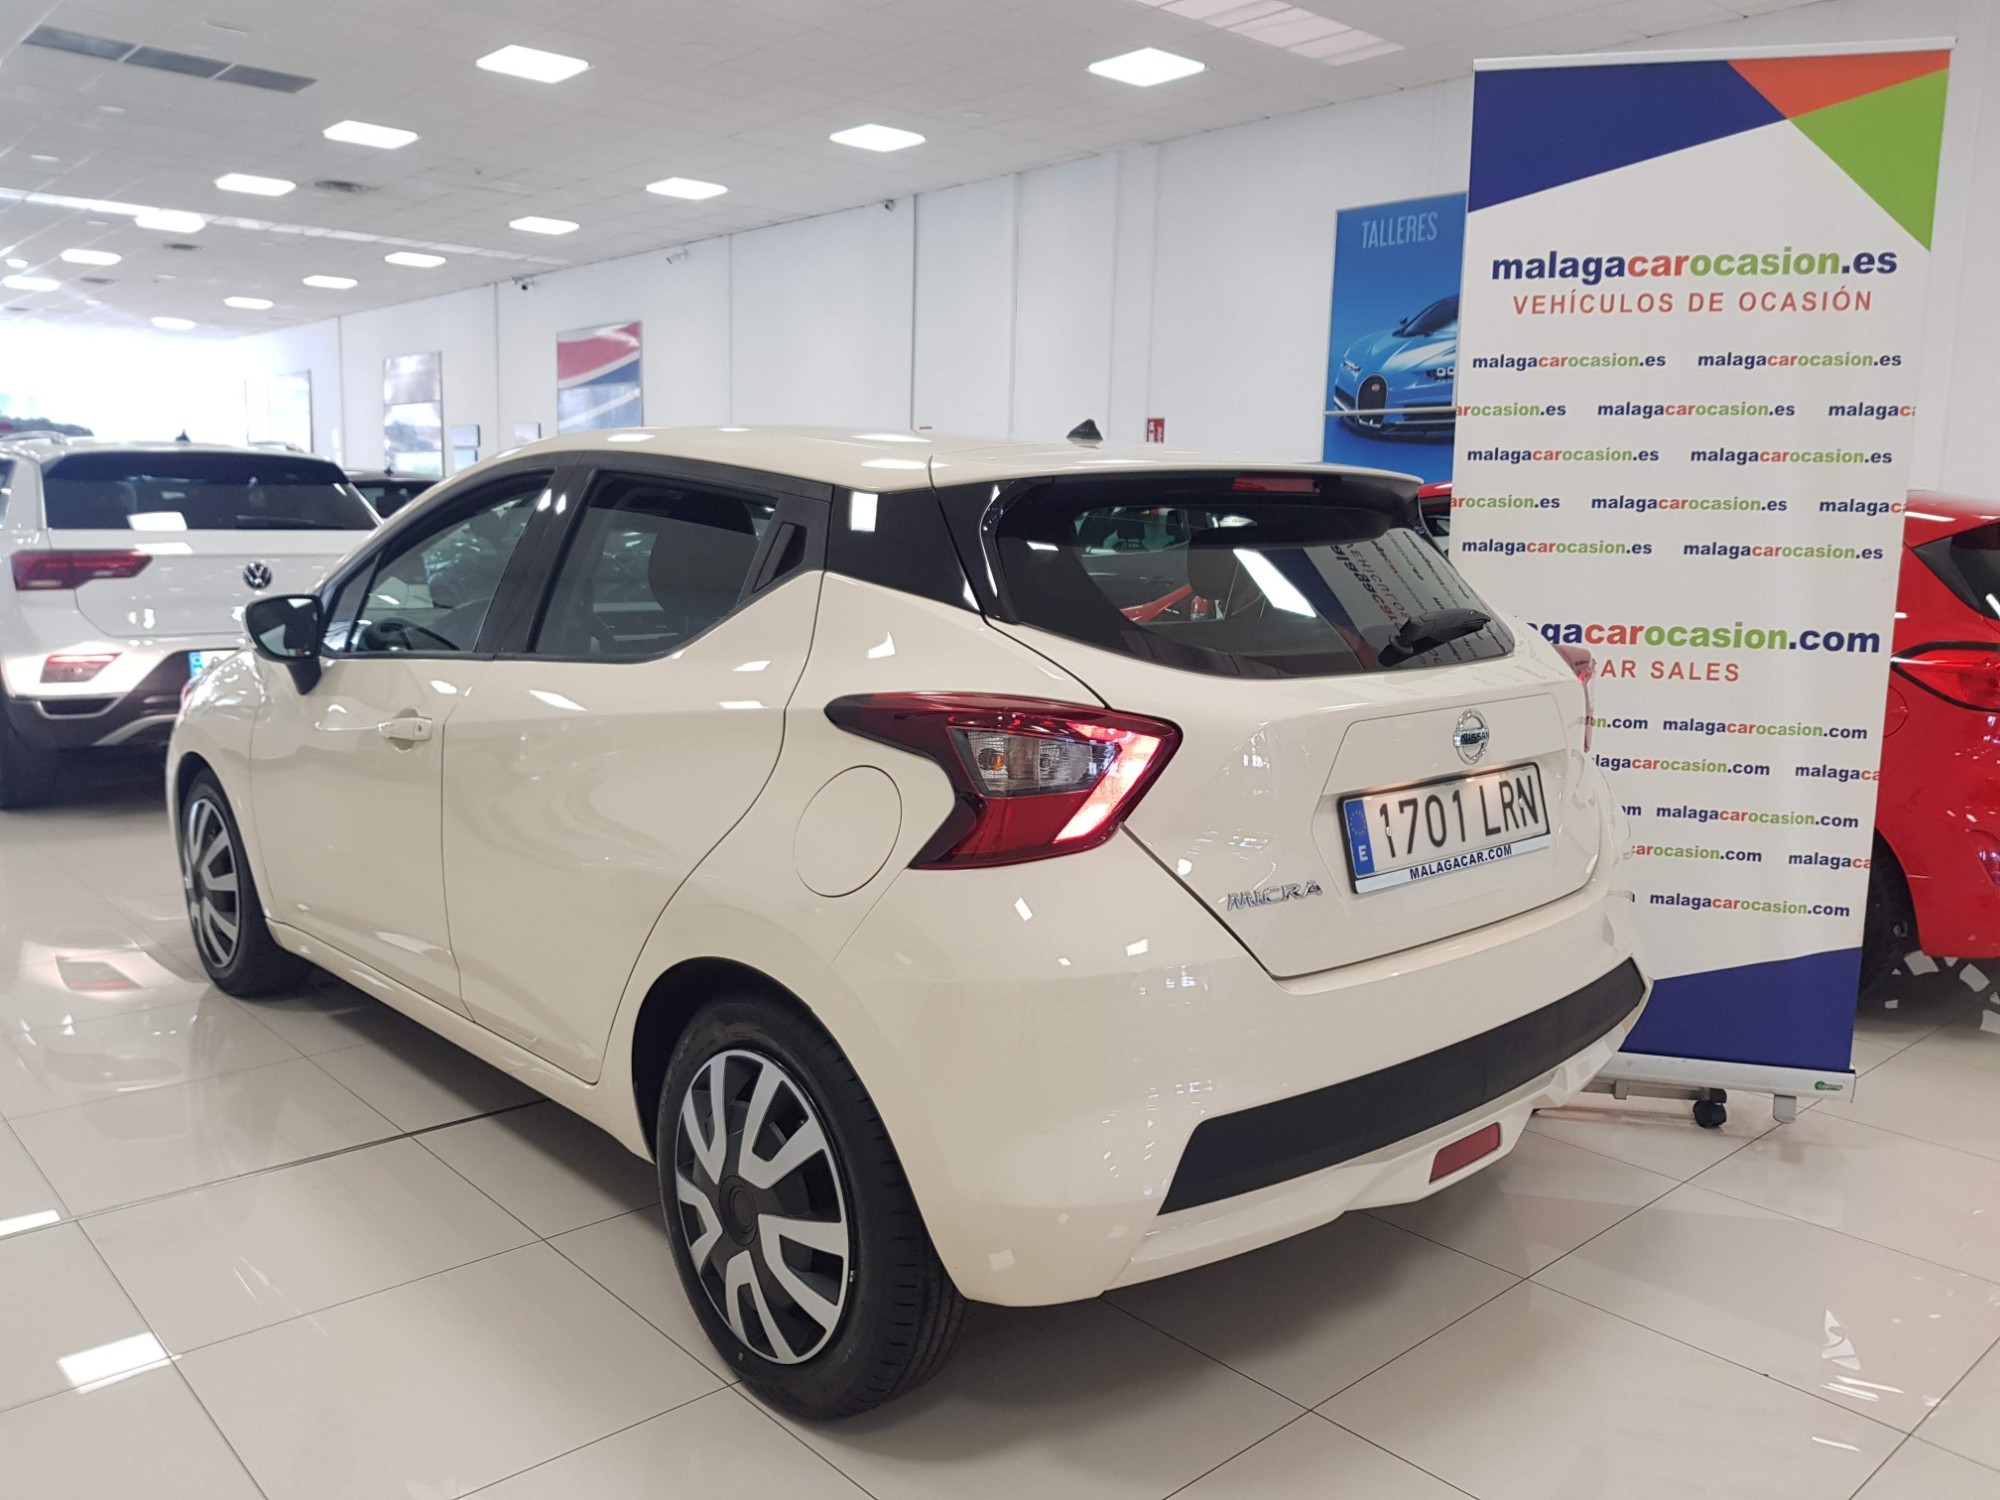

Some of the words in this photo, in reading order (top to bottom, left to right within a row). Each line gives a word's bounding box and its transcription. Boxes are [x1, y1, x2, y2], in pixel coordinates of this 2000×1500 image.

[1361, 212, 1438, 249] TALLERES
[1492, 246, 1897, 284] malagacarocasion.es
[1514, 289, 1673, 314] VEHÍCULOS
[1688, 293, 1723, 312] DE
[1739, 285, 1870, 311] OCASIÓN
[1473, 353, 1666, 371] malagacarocasion.es
[1698, 352, 1901, 369] malagacarocasion.es
[1598, 402, 1795, 419] malagacarocasion.es
[1467, 447, 1659, 464] malagacarocasion.es
[1691, 448, 1892, 465] malagacarocasion.es
[1592, 495, 1787, 512] malagacarocasion.es
[1462, 539, 1652, 556] malagacarocasion.es
[1684, 542, 1883, 559] malagacarocasion.es
[1526, 622, 1880, 653] gacarocasion.com
[1651, 661, 1738, 682] SALES
[1460, 731, 1489, 745] NISSAN
[1663, 718, 1867, 739] malagacarocasion.com
[1592, 754, 1770, 775] lagacarocasion.com
[1380, 790, 1466, 858] 1701
[1479, 775, 1539, 837] LRN
[1656, 805, 1858, 828] malagacarocasion.com
[1357, 844, 1369, 862] E
[1409, 844, 1513, 880] MALAGACAR.COM
[1632, 845, 1762, 862] arocasion.com
[1227, 881, 1323, 911] MICRA
[1650, 893, 1849, 917] malagacarocasion.com
